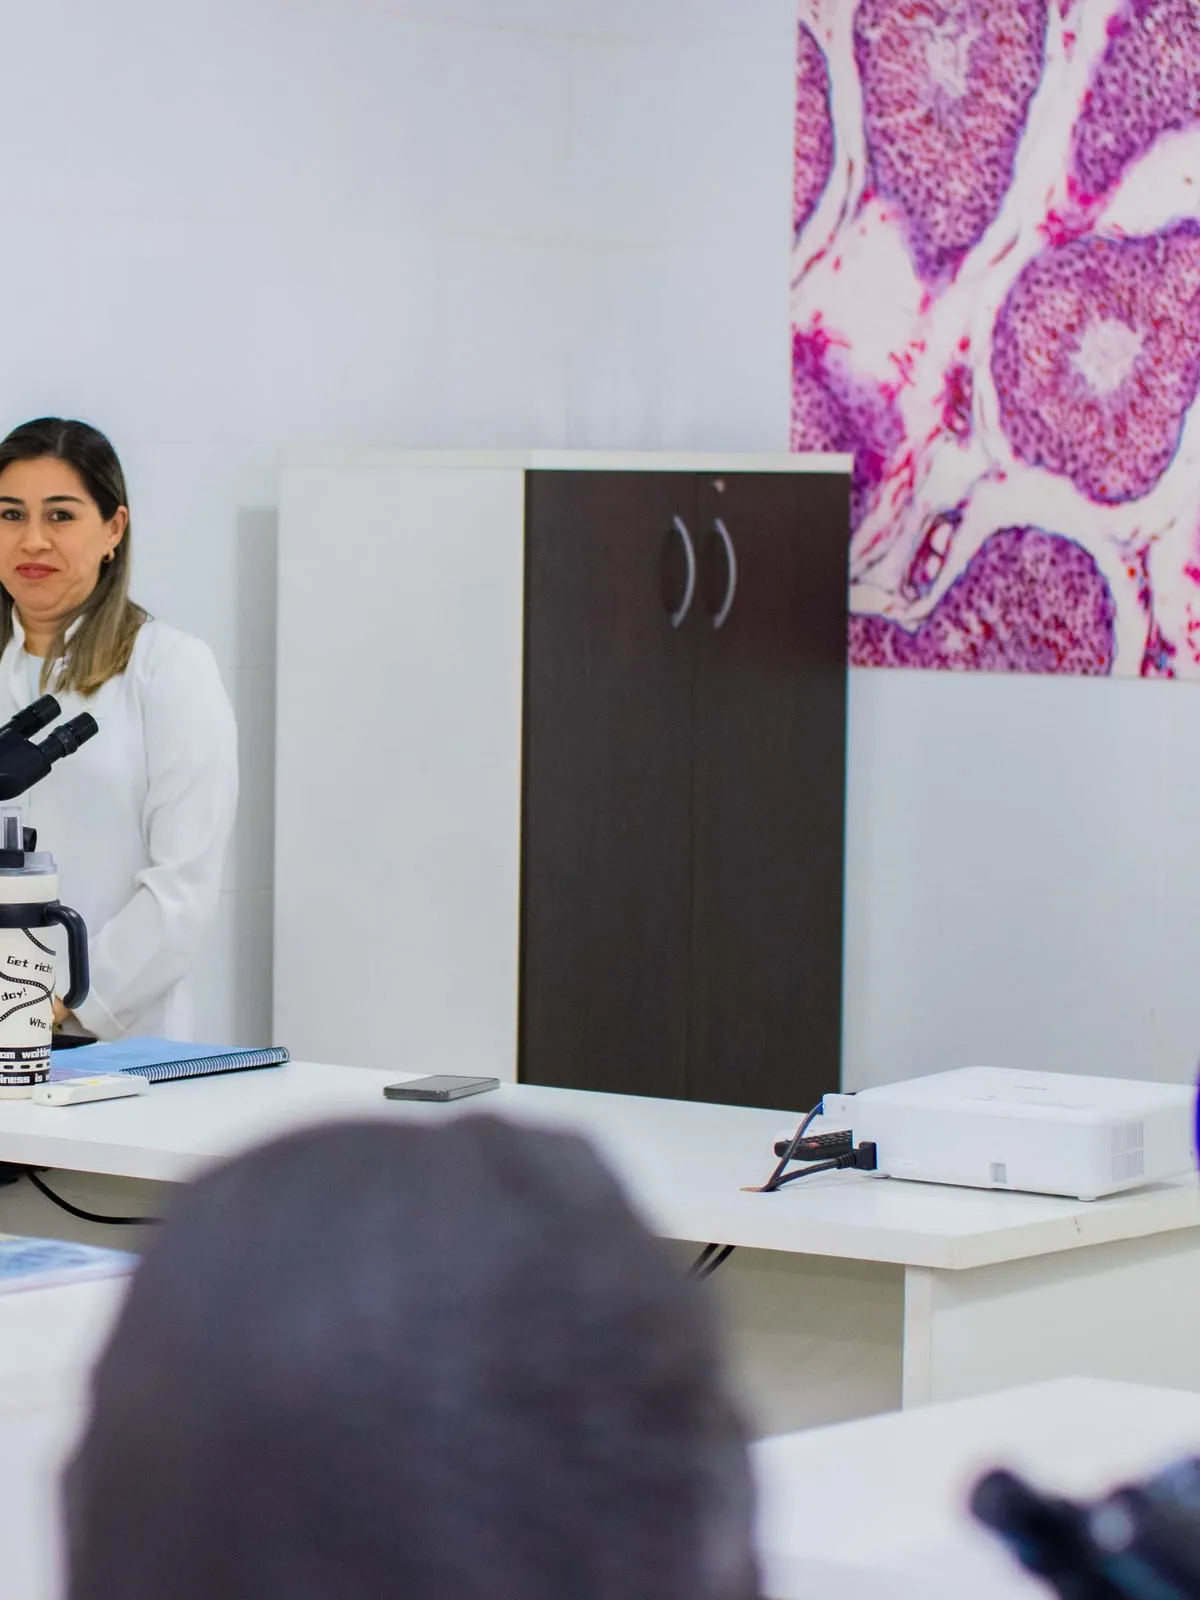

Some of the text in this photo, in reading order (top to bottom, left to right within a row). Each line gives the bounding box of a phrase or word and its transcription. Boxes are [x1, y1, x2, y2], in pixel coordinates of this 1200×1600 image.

[6, 955, 29, 968] Get
[1, 987, 28, 1002] day!
[0, 1051, 16, 1060] am
[34, 1073, 43, 1083] is
